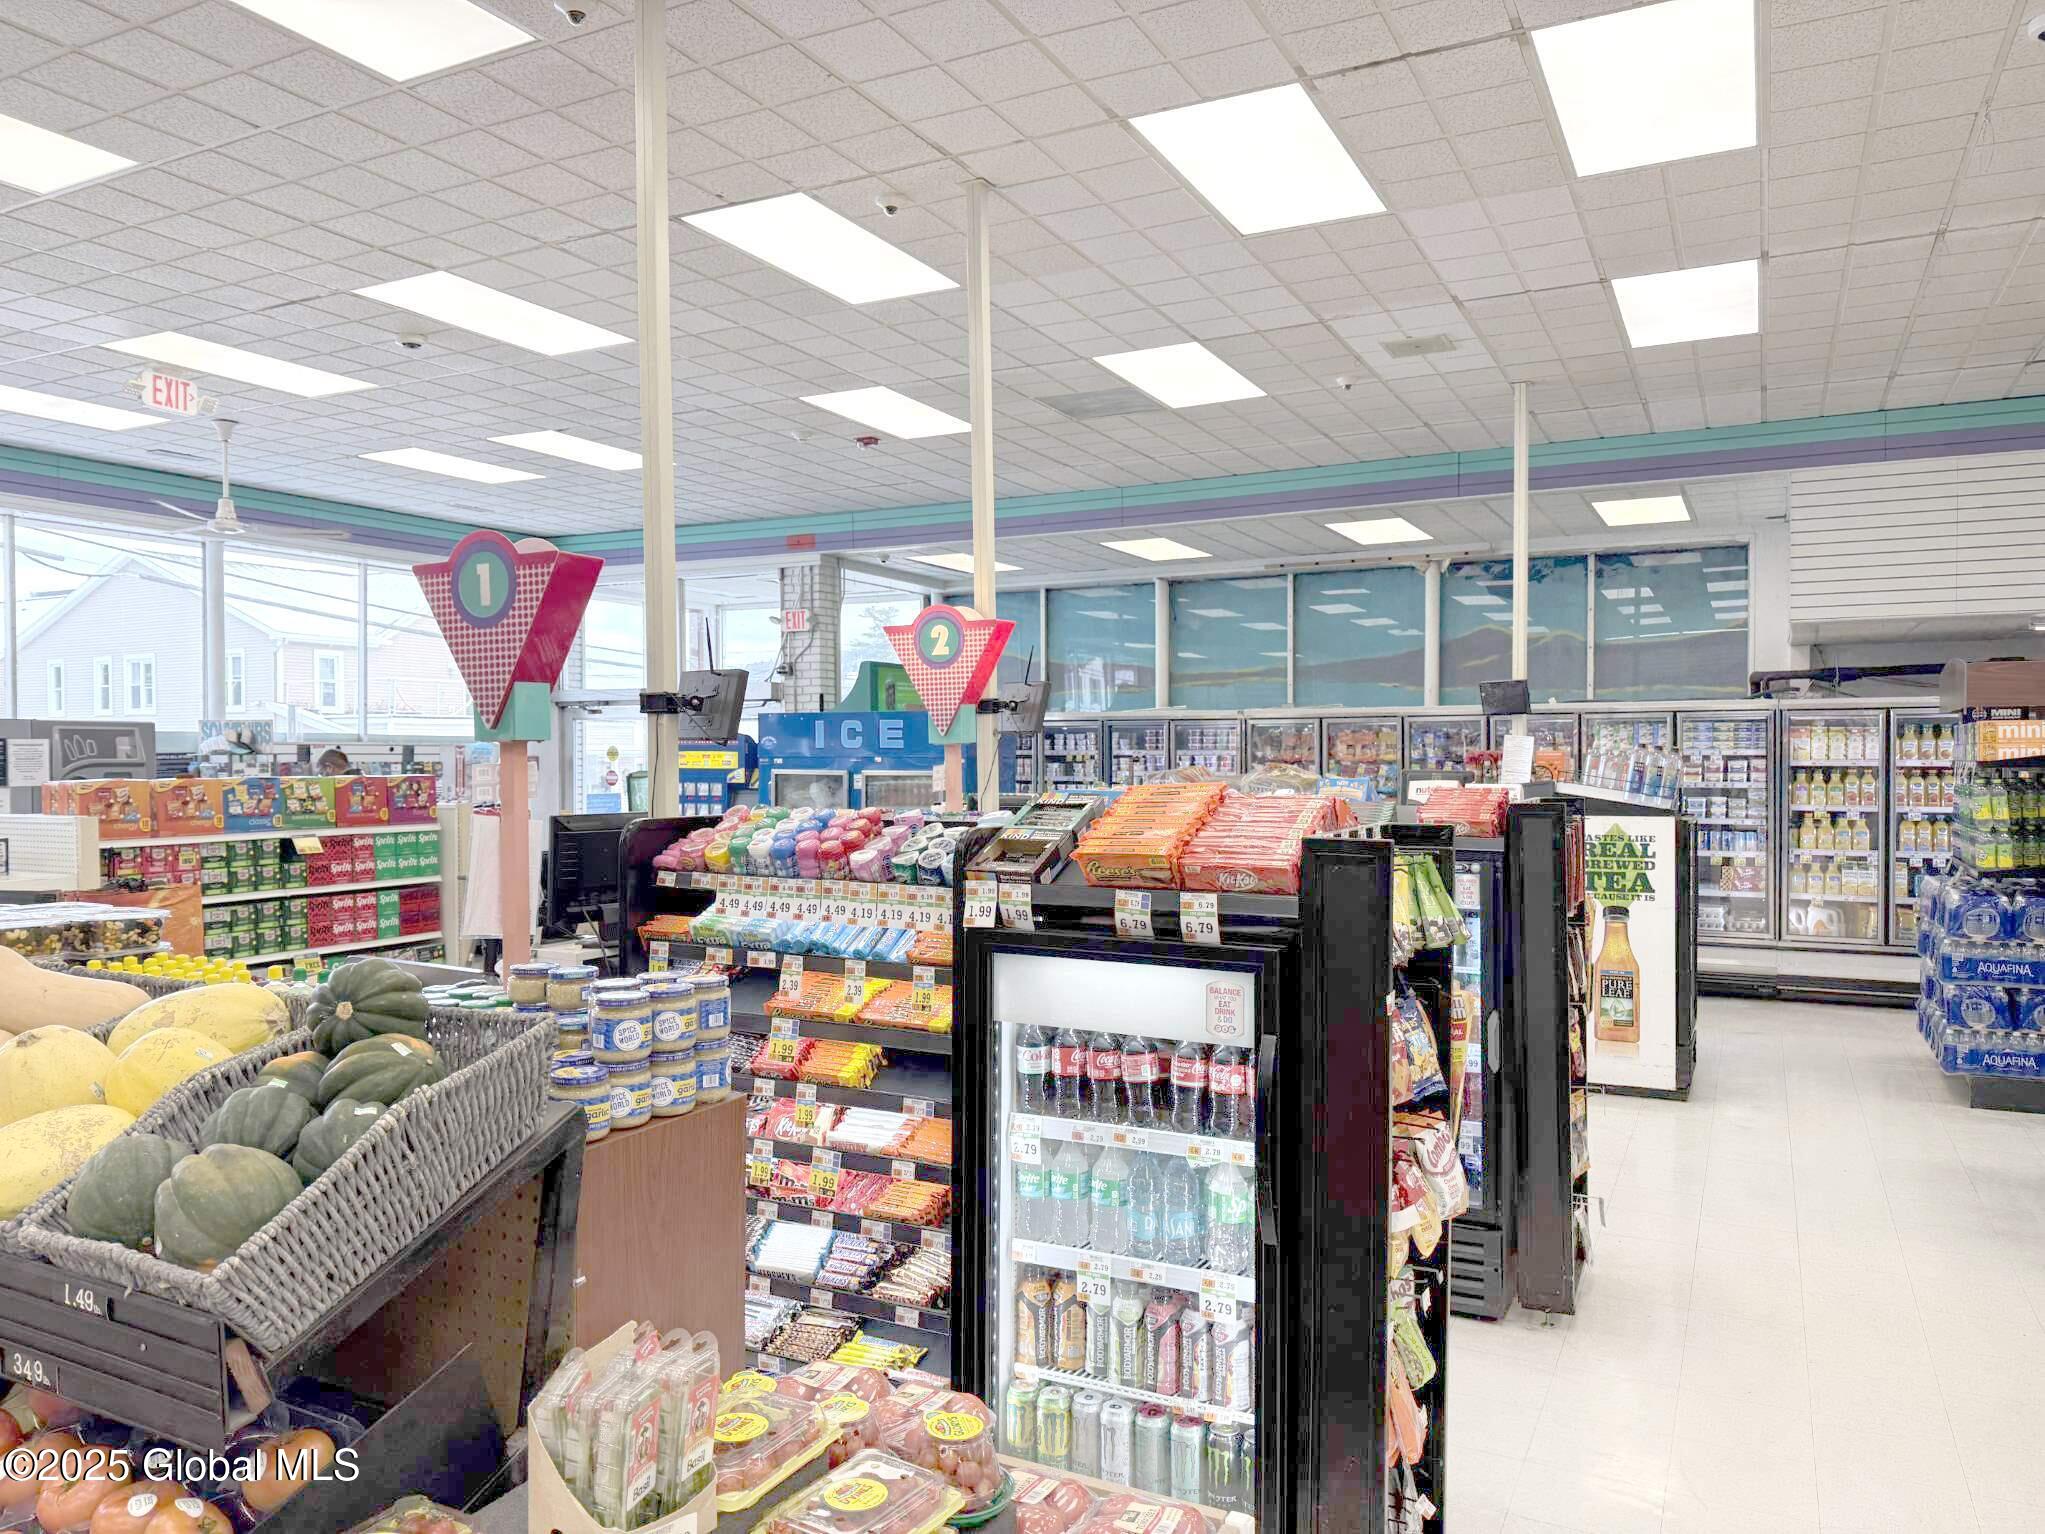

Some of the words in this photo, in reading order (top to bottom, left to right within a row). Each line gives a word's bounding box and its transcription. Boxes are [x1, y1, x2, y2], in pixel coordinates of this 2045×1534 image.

[153, 374, 192, 412] EXIT
[476, 563, 492, 606] 1
[786, 611, 806, 630] EXIT
[930, 624, 950, 656] 2
[815, 718, 905, 750] ICE
[1585, 834, 1624, 842] ASTES
[1585, 842, 1656, 859] REAL
[1088, 862, 1136, 877] Reese's
[1585, 871, 1655, 893] TEA
[720, 899, 739, 909] 4.49
[744, 901, 763, 911] 4.49
[770, 902, 790, 912] 4.49
[797, 904, 817, 914] 4.49
[825, 905, 846, 916] 4.49
[851, 907, 873, 918] 4.19
[881, 909, 902, 920] 4.19
[969, 904, 992, 918] 1.99
[1004, 908, 1028, 921] 1.99
[909, 912, 931, 923] 4.19
[937, 913, 953, 924] 4.1
[1120, 918, 1147, 930] 6.79
[1186, 922, 1214, 934] 6.79
[1976, 961, 2032, 976] AQUAFINA
[782, 979, 798, 990] 2.39
[847, 984, 862, 996] 2.39
[1602, 980, 1632, 989] PURE
[1209, 986, 1241, 996] BALANCE
[1602, 988, 1632, 998] LEAF
[914, 992, 930, 1004] 1.99
[1218, 1000, 1231, 1008] EAT
[1215, 1008, 1235, 1016] DRINK
[658, 1016, 676, 1027] SPICE
[618, 1025, 637, 1036] SPICE
[658, 1023, 680, 1035] WORLD
[618, 1031, 640, 1044] WORLD
[772, 1043, 793, 1054] 1.99
[1982, 1054, 2036, 1068] AQUAFINA
[611, 1092, 626, 1101] PICE
[798, 1109, 813, 1120] 1.99
[1014, 1143, 1037, 1154] 2.79
[754, 1165, 768, 1177] 1.99
[812, 1174, 834, 1188] 1.99
[1081, 1281, 1106, 1296] 2.79
[1205, 1300, 1232, 1314] 2.79
[1097, 1316, 1105, 1367] BODYARMOR
[1124, 1328, 1132, 1379] BODYARMOR
[1147, 1330, 1155, 1384] BODYARMOR
[687, 1450, 705, 1472] Basil
[633, 1476, 651, 1502] Basil
